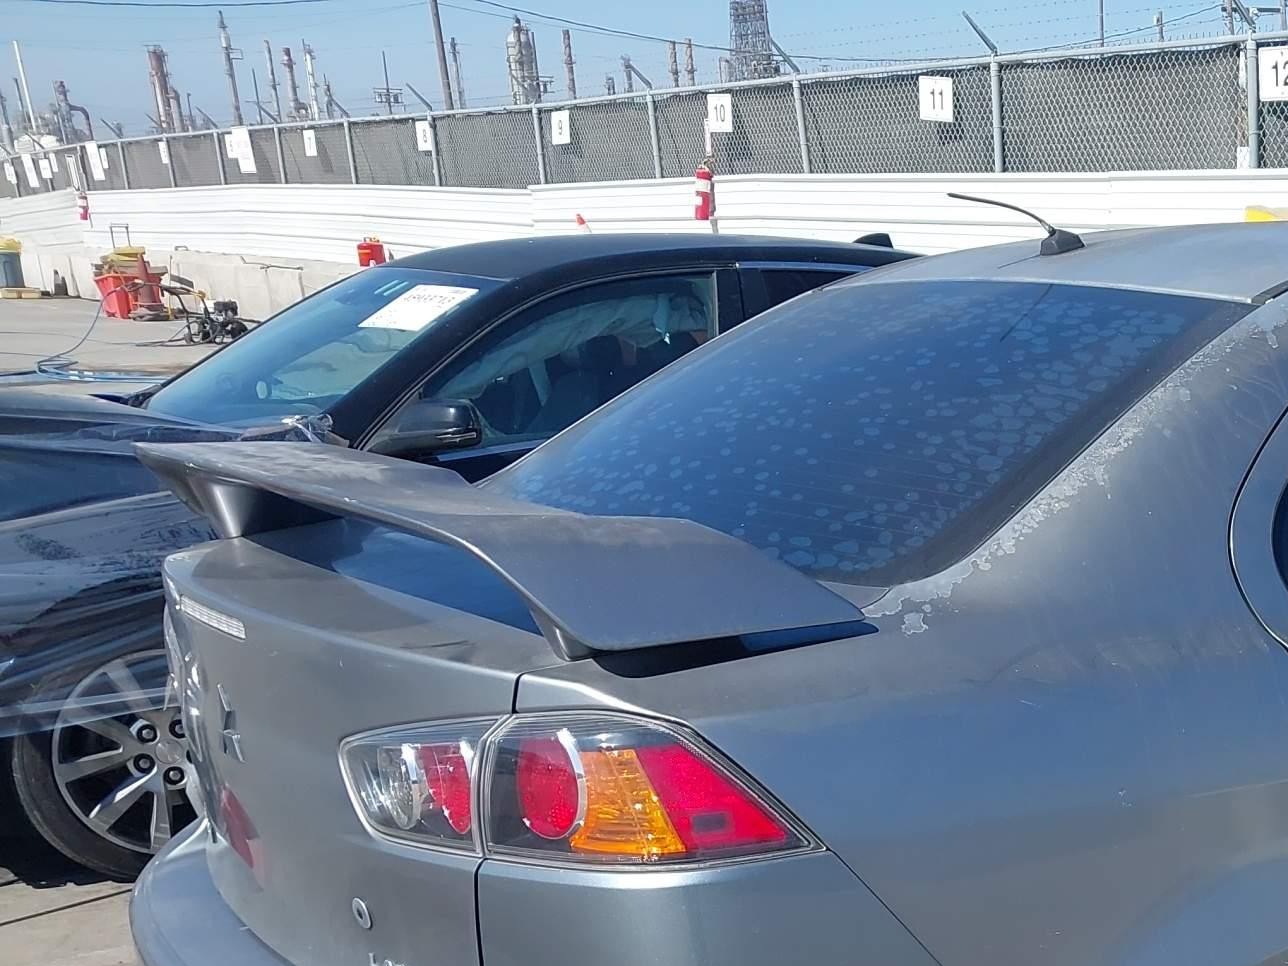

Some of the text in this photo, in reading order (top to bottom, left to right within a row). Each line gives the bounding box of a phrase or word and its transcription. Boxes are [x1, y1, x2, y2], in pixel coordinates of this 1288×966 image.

[929, 88, 945, 111] 11
[713, 103, 726, 123] 10
[557, 119, 563, 136] 9
